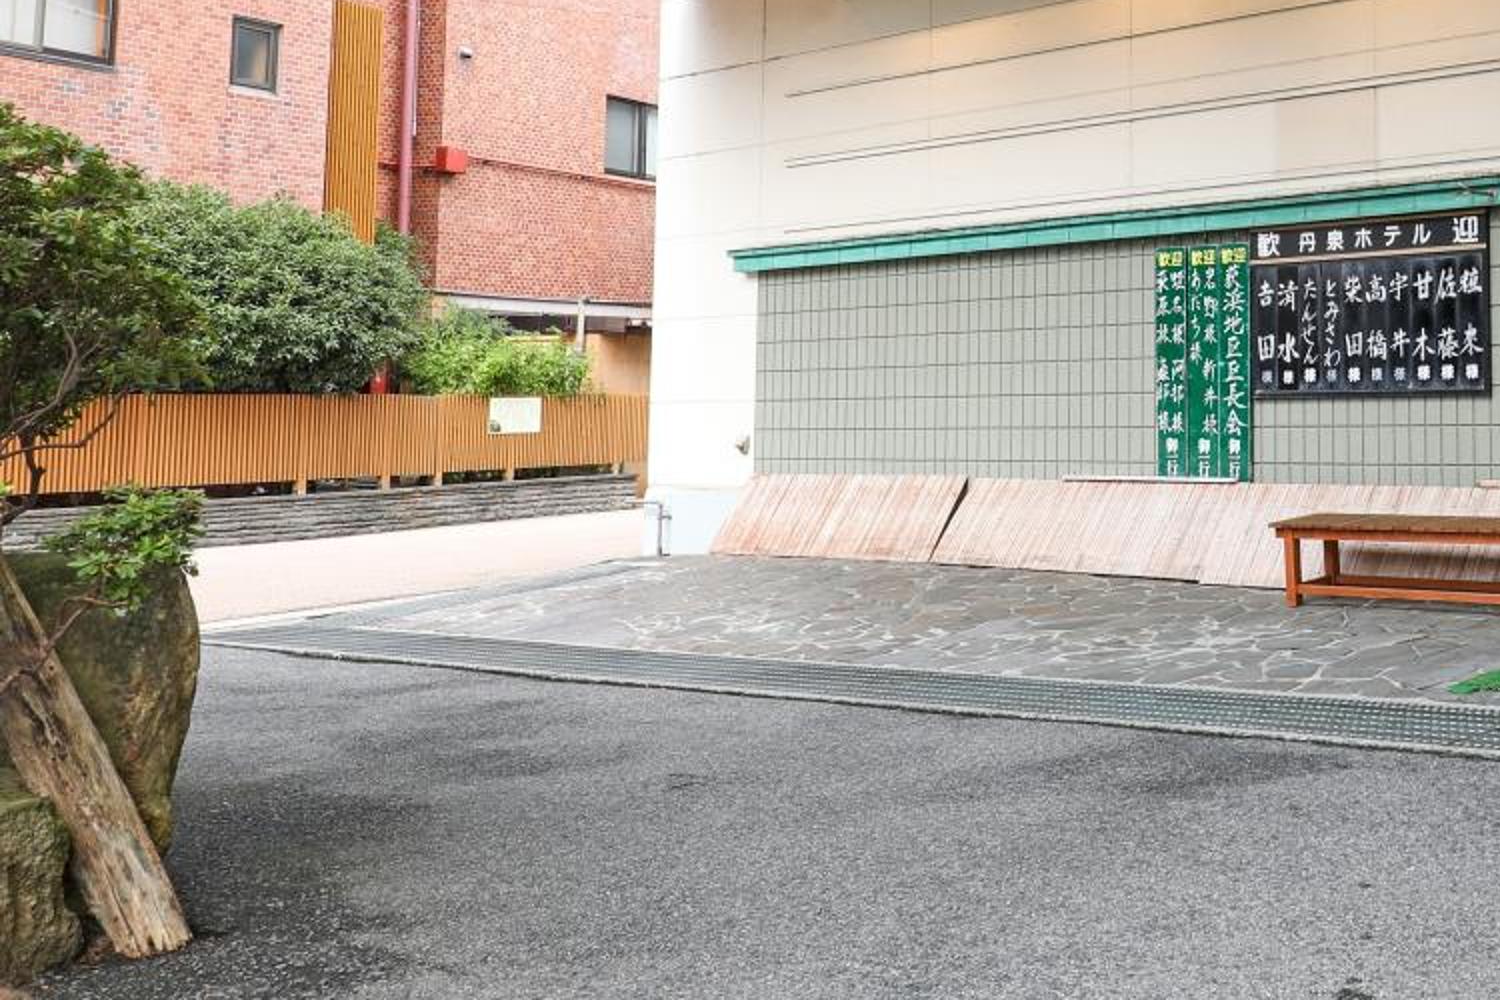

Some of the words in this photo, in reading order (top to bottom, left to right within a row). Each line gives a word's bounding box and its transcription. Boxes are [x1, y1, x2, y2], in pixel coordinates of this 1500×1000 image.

[1299, 223, 1432, 253] 丹泉ホテル
[1452, 216, 1479, 244] 迎
